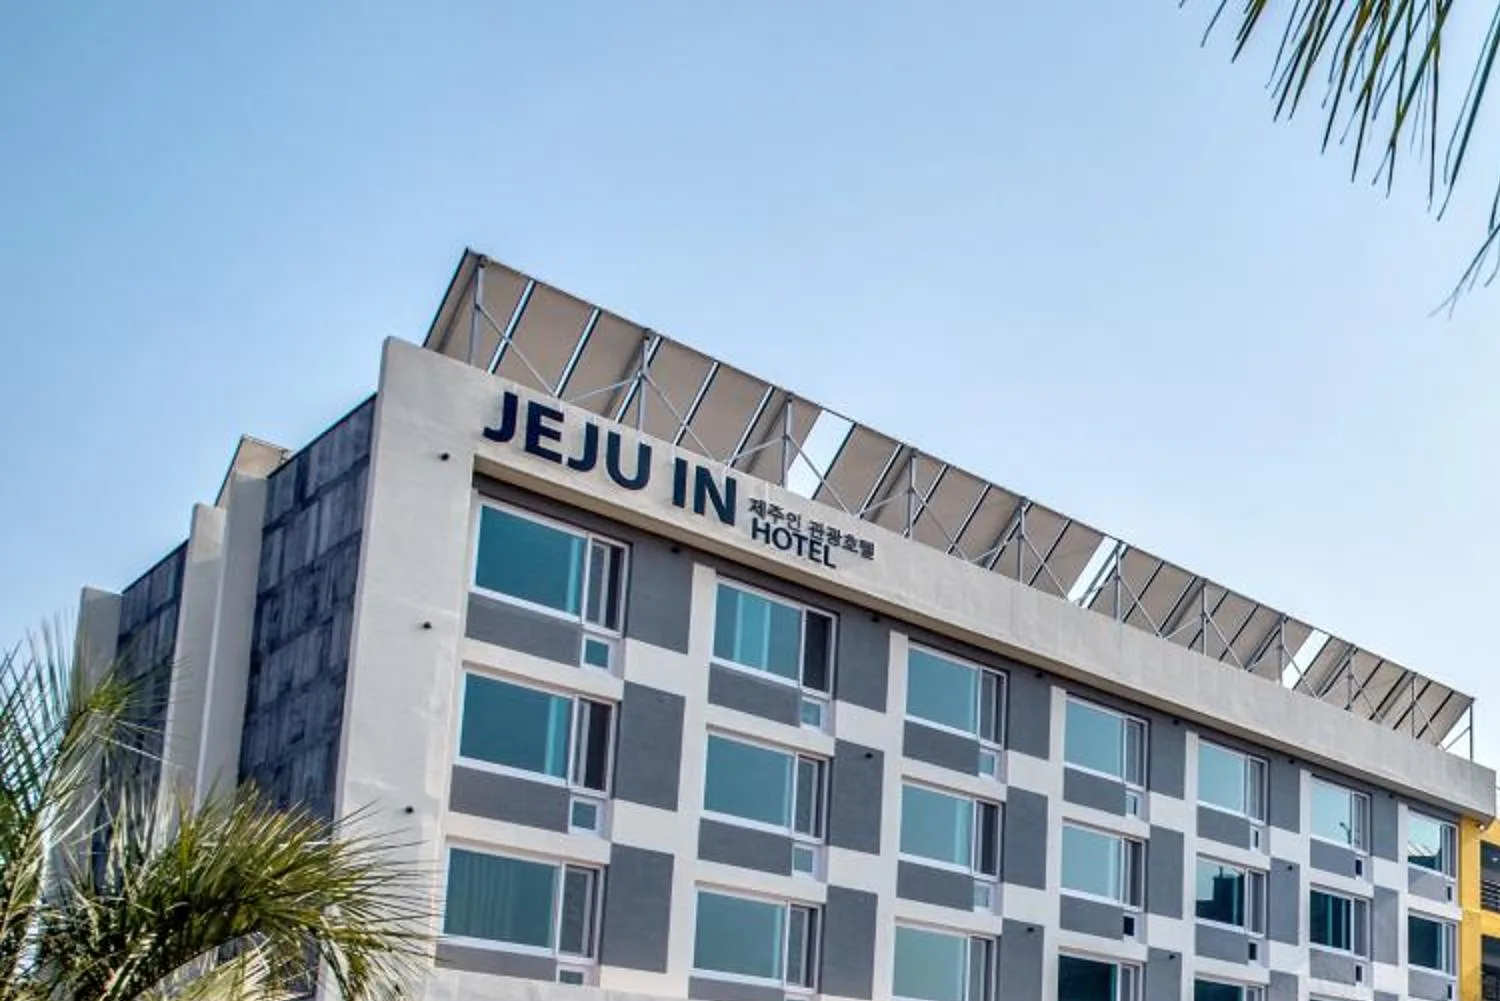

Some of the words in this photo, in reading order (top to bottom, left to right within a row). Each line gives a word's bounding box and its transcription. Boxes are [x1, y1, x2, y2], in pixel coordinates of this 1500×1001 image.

[483, 391, 652, 491] JEJU
[672, 457, 737, 526] IN
[748, 497, 802, 532] 제주인
[808, 519, 875, 561] 관광호텔
[751, 517, 837, 569] HOTEL
